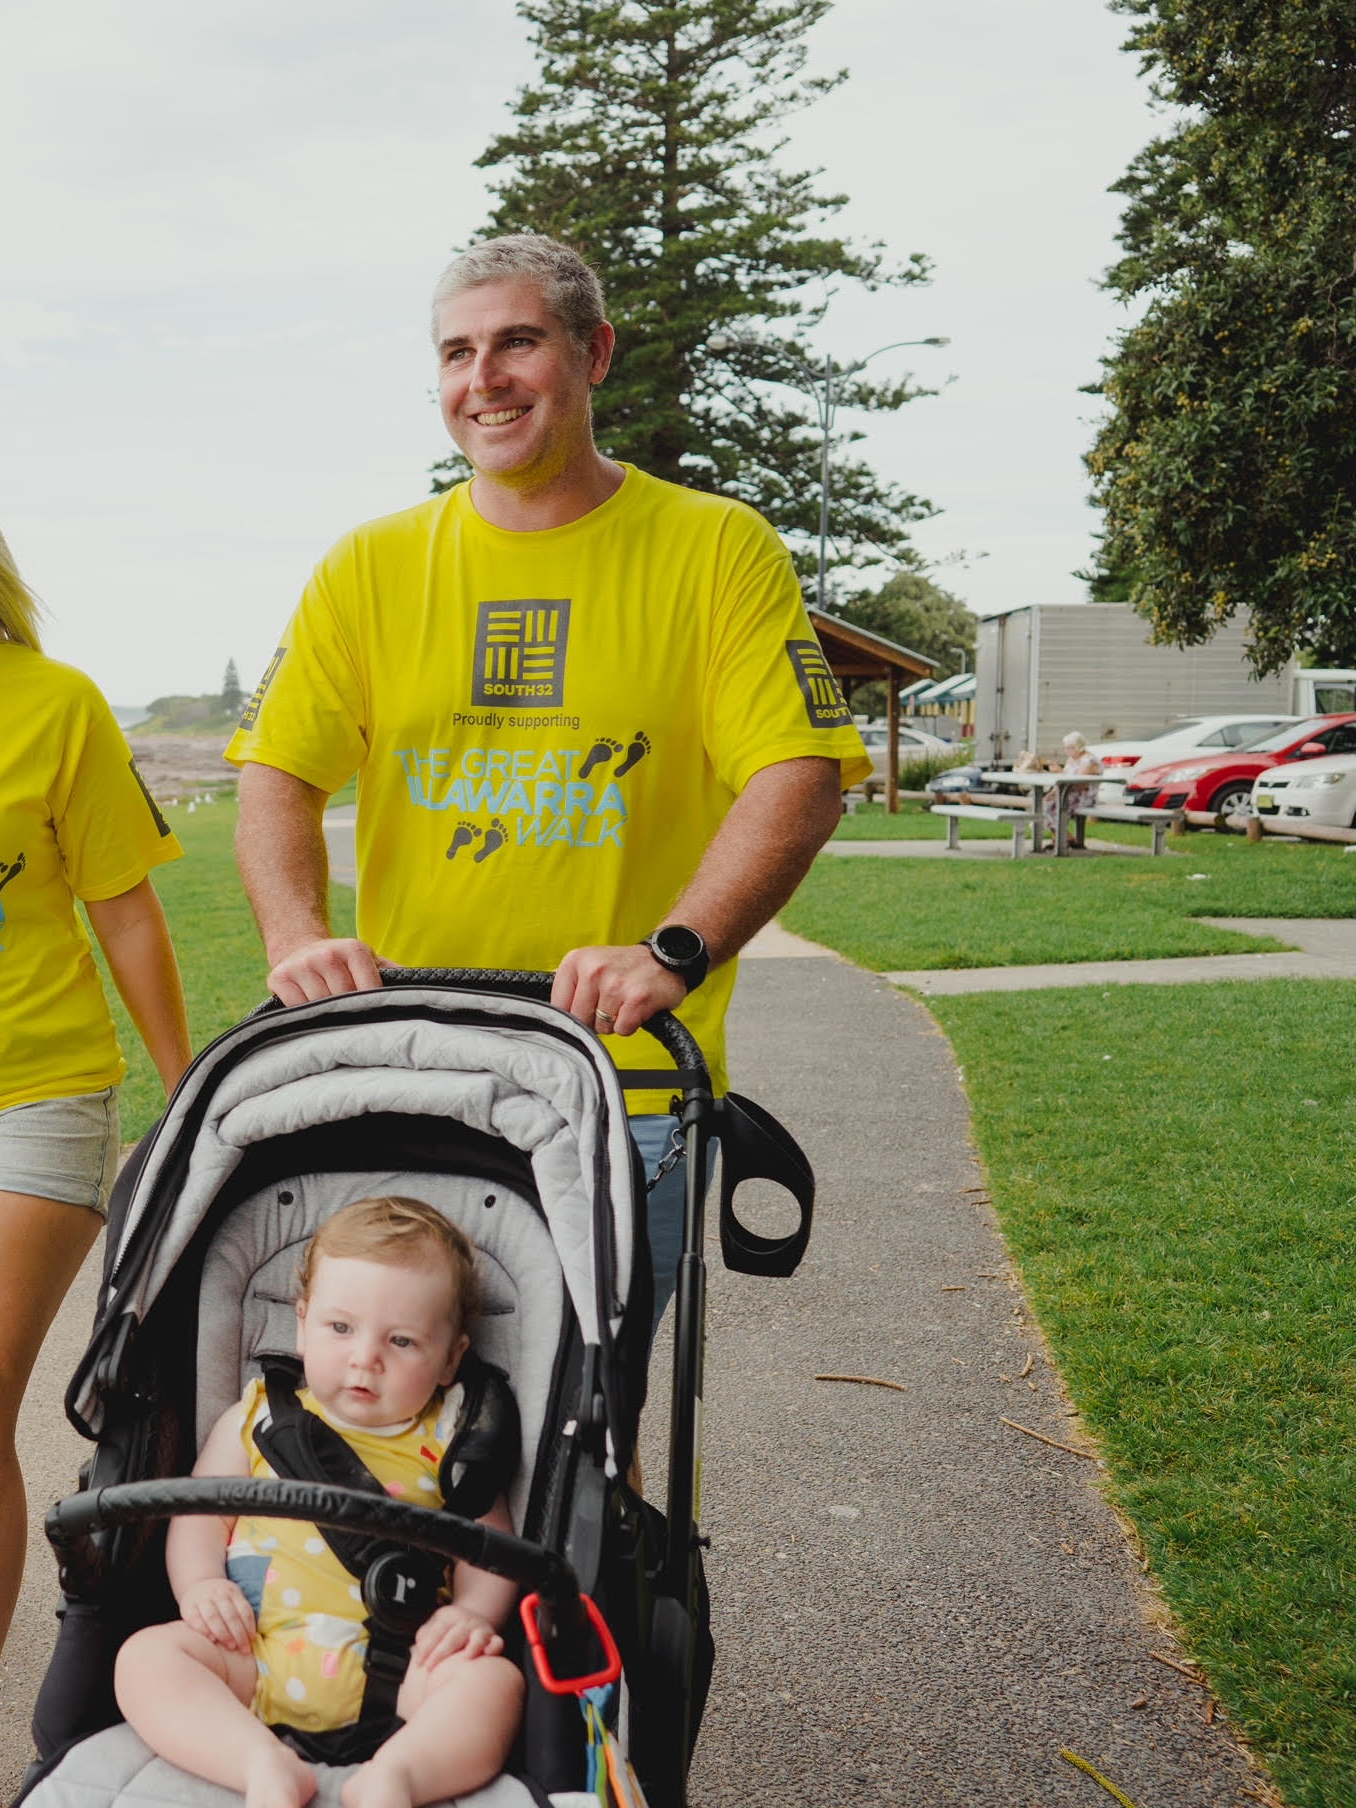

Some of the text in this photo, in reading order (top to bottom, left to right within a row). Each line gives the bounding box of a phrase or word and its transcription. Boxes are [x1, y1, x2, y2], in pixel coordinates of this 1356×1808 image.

[483, 683, 554, 696] SOUTH32
[453, 713, 581, 730] Proudly supporting
[815, 706, 848, 719] SOUT
[392, 747, 582, 781] THE GREAT
[406, 775, 628, 817] ILLAWARRA
[516, 815, 628, 848] WALK
